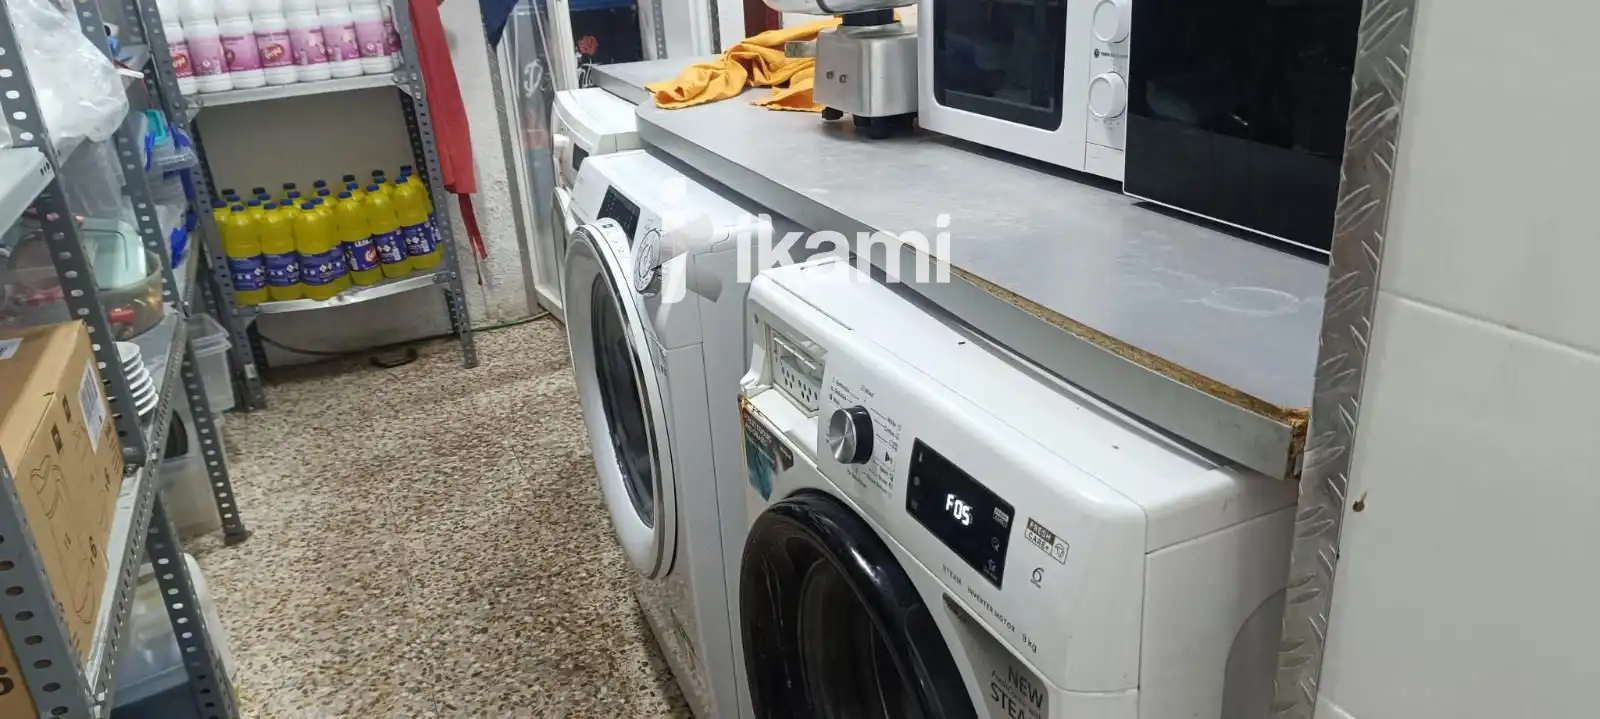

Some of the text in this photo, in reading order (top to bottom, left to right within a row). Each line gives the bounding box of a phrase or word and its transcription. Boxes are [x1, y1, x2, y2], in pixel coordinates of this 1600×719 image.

[1028, 531, 1050, 551] CARE+
[1029, 521, 1051, 541] FRESH
[942, 564, 962, 585] STEAM
[968, 586, 993, 613] INVERTER
[995, 609, 1016, 633] MOTOR
[989, 681, 1031, 719] STEA
[1008, 664, 1043, 709] NEW
